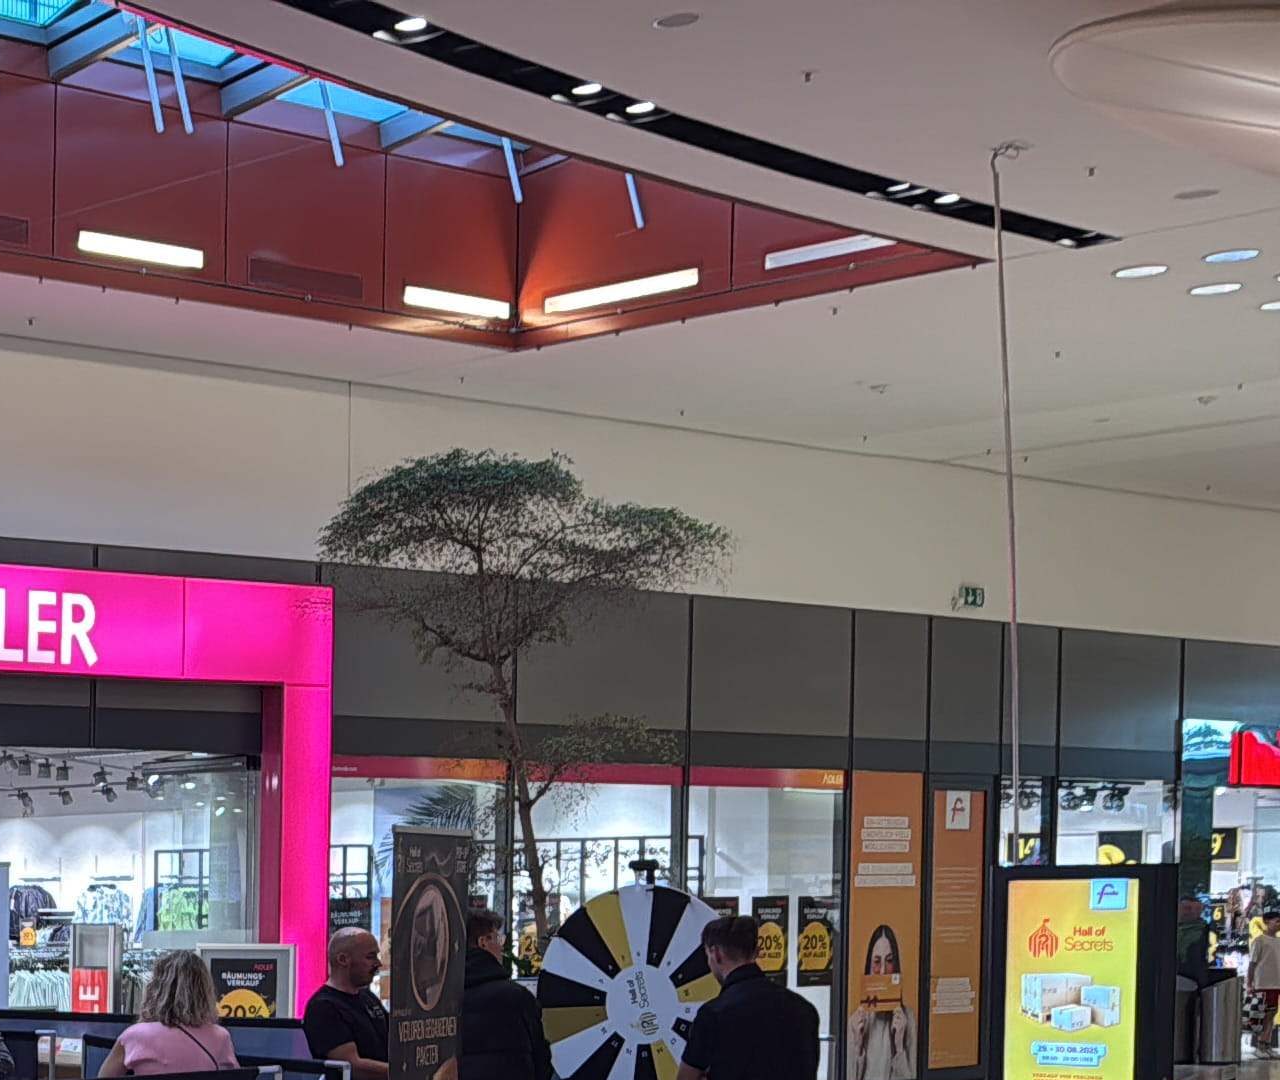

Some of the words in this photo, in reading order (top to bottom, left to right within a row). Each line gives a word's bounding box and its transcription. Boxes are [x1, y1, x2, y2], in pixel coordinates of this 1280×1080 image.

[1072, 925, 1093, 938] Hall
[1094, 926, 1107, 938] of
[758, 934, 783, 951] 20%
[802, 934, 827, 951] 20%
[1064, 937, 1114, 952] Secrets
